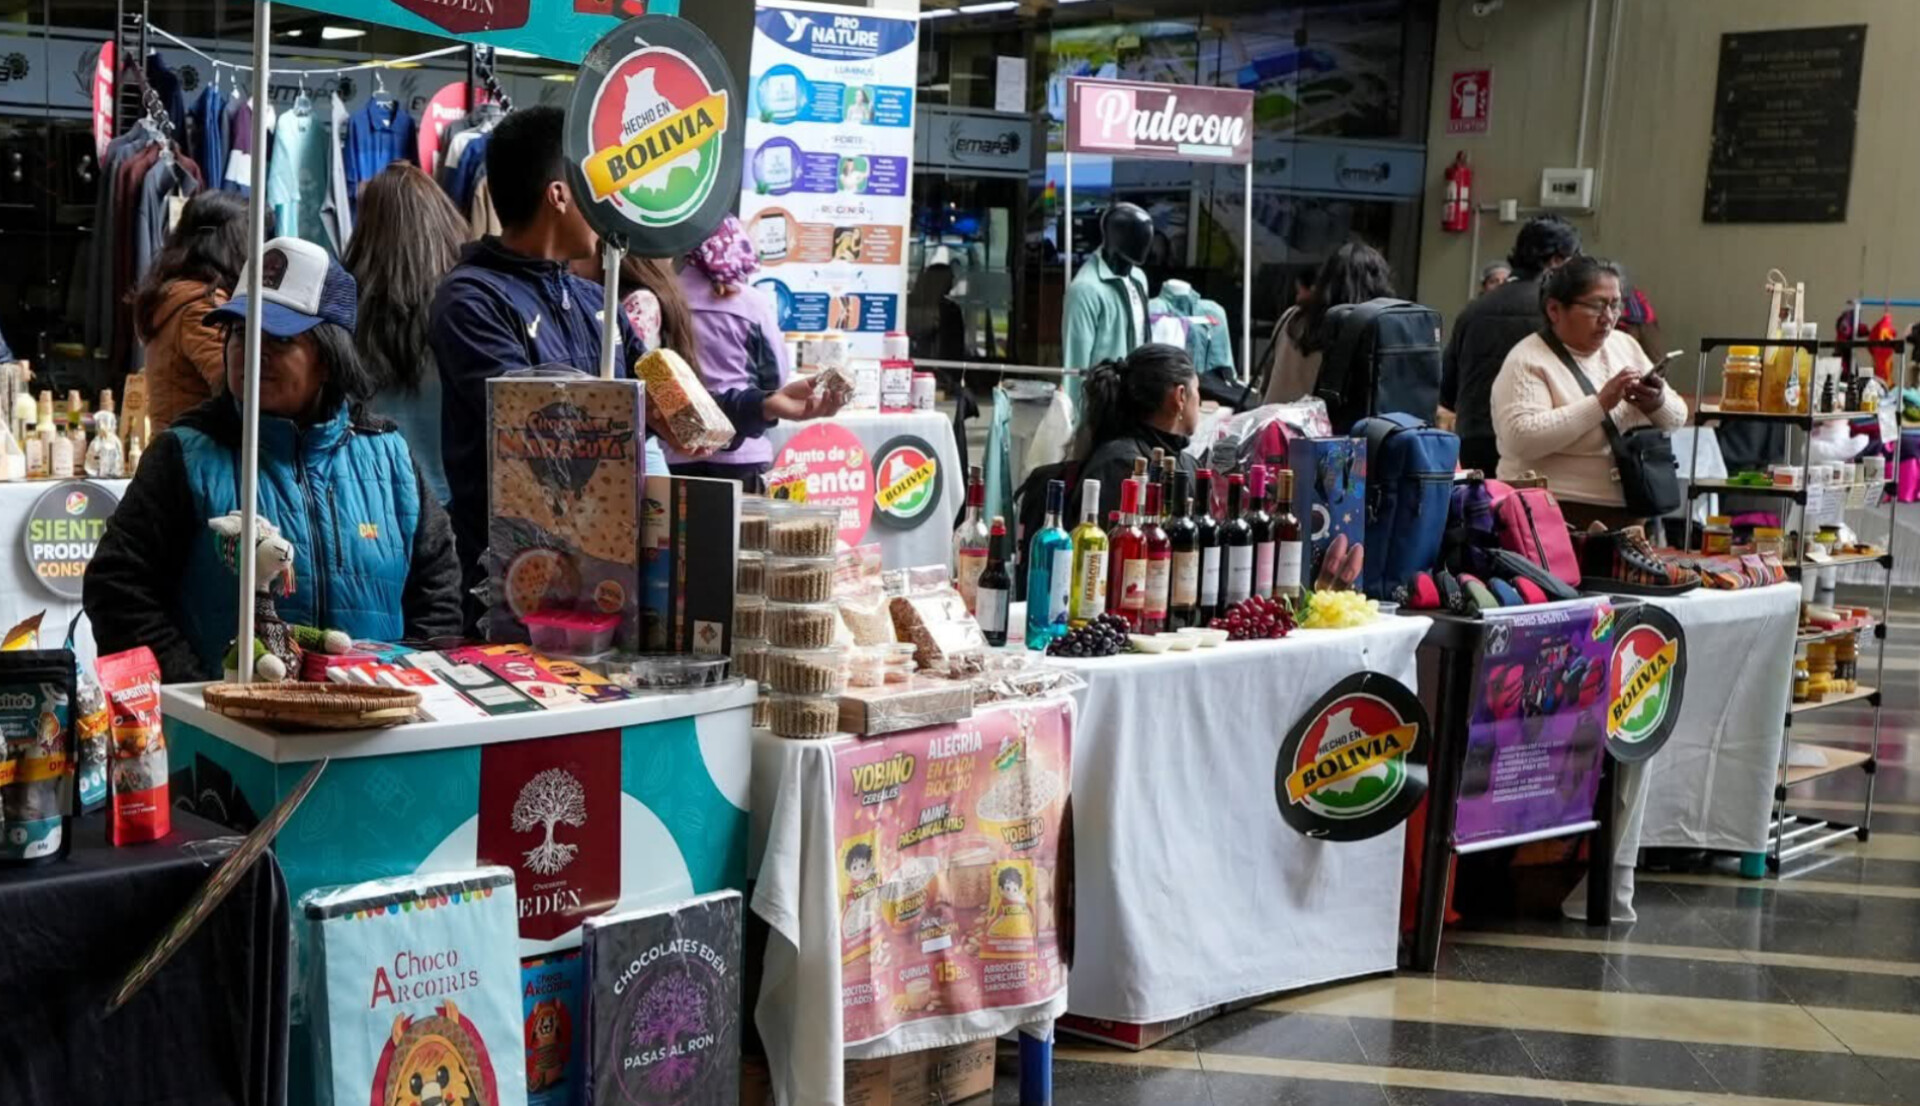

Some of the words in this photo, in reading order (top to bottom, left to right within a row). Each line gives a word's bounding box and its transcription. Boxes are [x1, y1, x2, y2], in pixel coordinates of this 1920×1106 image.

[811, 26, 879, 48] NATURE
[834, 15, 859, 30] PRO
[623, 107, 656, 136] HECHO
[655, 100, 671, 118] EN
[1095, 89, 1246, 146] Padecon
[606, 107, 714, 183] BOLIVIA
[785, 447, 826, 465] Punto
[828, 445, 846, 462] de
[806, 467, 866, 494] enta
[884, 466, 929, 502] BOLIVIA
[30, 519, 103, 541] SIENT
[33, 542, 94, 560] PRODU
[1613, 654, 1668, 721] BOLIVIA
[1318, 734, 1348, 755] HECHO
[1348, 729, 1362, 742] EN
[851, 751, 915, 796] YOBIÑO
[1302, 733, 1400, 788] BOLIVIA
[518, 888, 582, 919] EDÉN
[613, 938, 698, 995] CHOCOLATES
[935, 960, 956, 983] 15
[370, 966, 479, 1009] ARCOIRIS
[624, 1046, 667, 1071] PASAS
[668, 1042, 686, 1058] AL
[688, 1033, 715, 1053] RON
